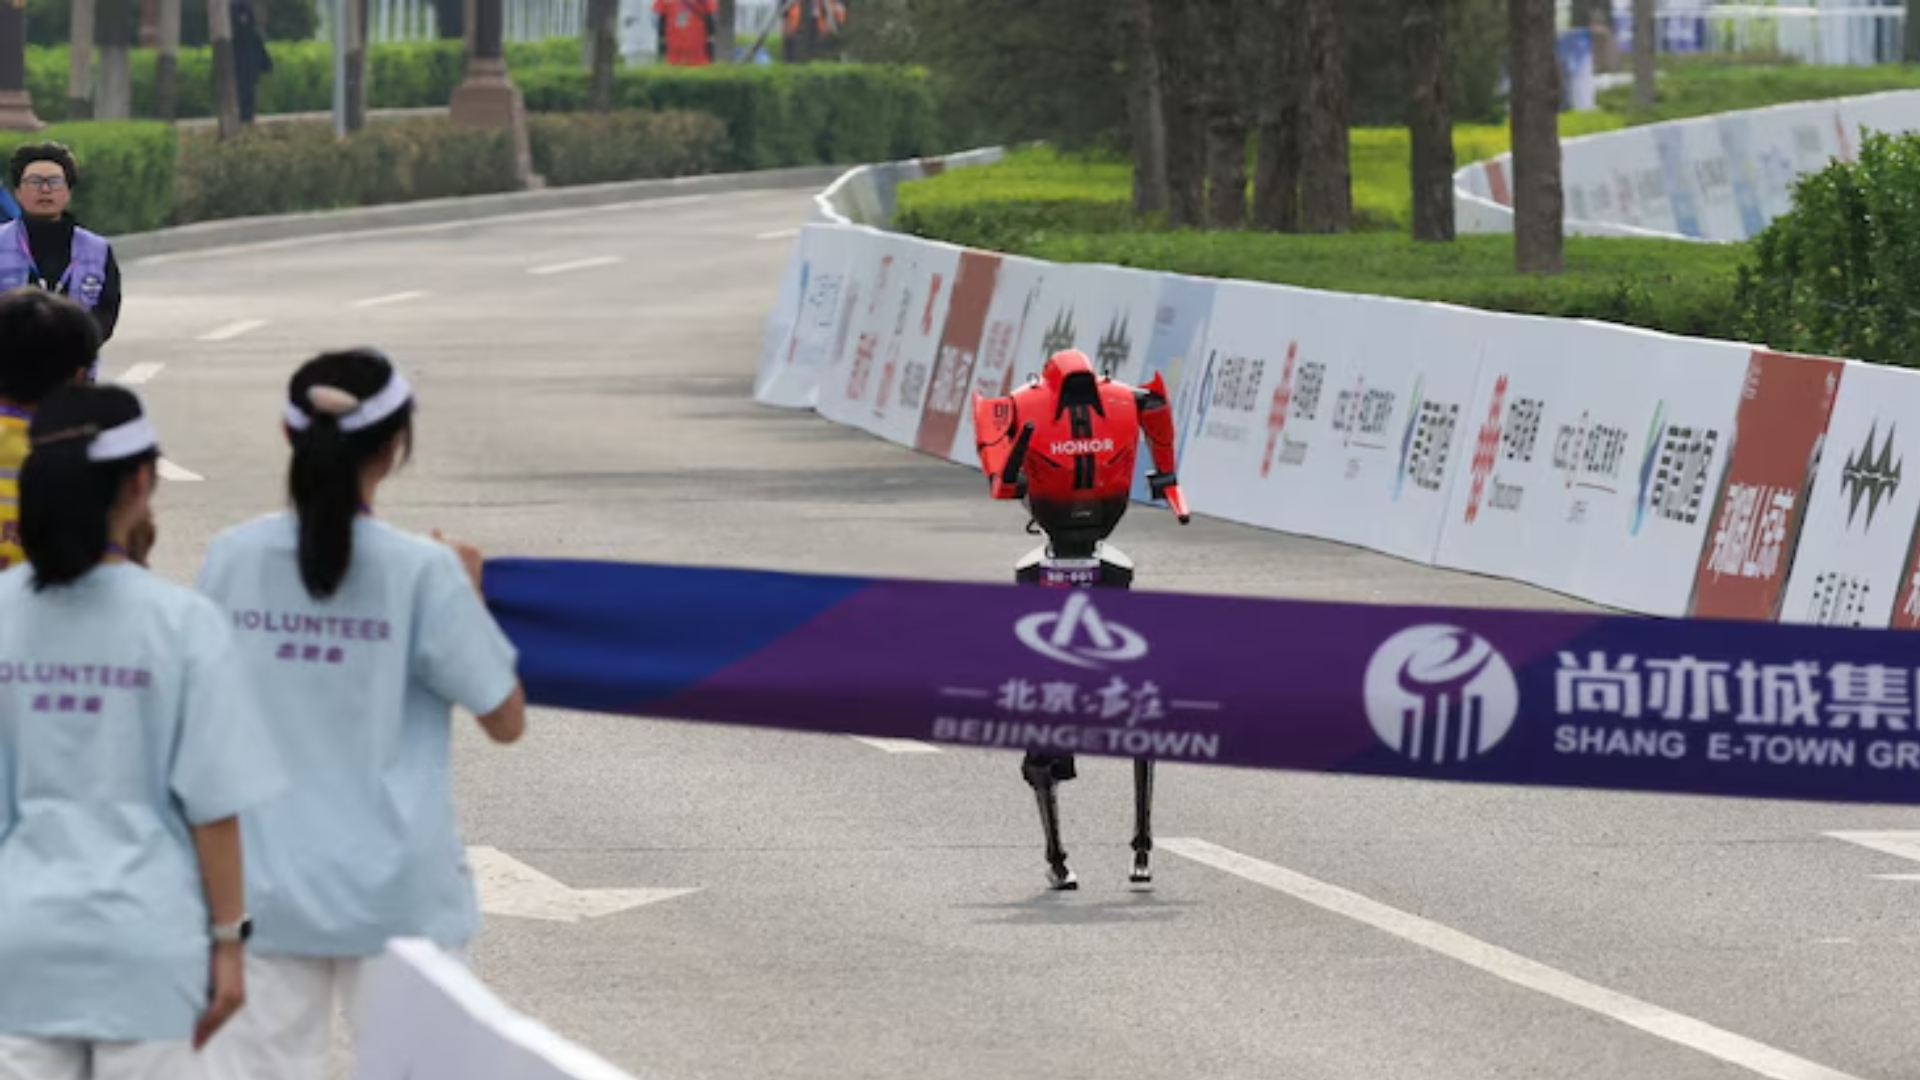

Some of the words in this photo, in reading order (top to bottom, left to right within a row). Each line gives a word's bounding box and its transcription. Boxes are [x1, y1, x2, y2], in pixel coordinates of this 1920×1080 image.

[1051, 438, 1114, 455] HONOR
[1554, 650, 1920, 731] 尚亦城集
[1554, 724, 1687, 759] SHANG
[1707, 733, 1856, 767] E-TOWN
